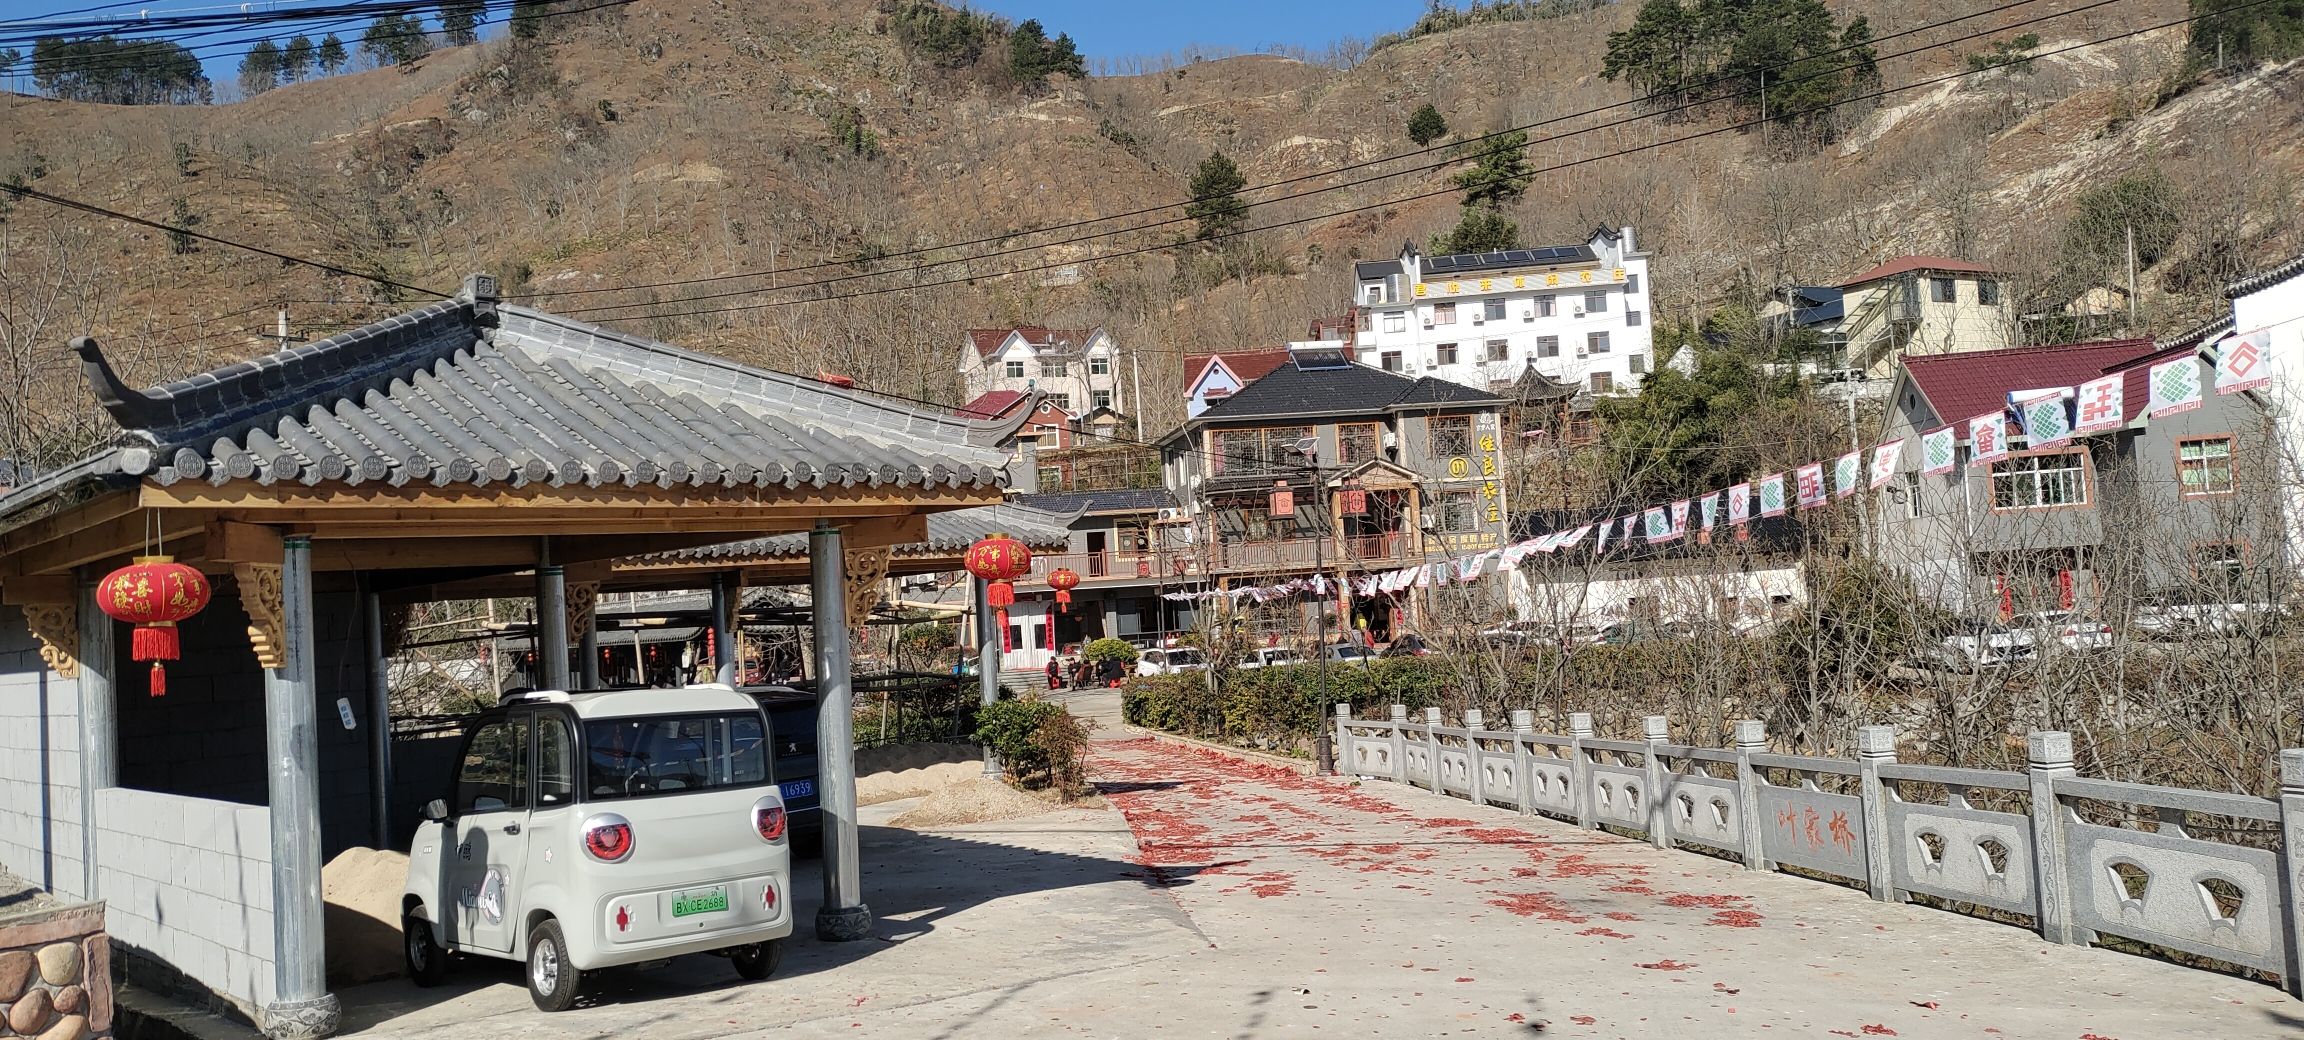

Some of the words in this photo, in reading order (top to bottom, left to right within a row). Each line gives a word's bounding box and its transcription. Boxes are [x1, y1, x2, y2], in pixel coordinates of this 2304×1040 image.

[1479, 433, 1501, 522] 佳良农庄
[785, 782, 811, 796] 16939
[1777, 800, 1856, 857] 叶家桥
